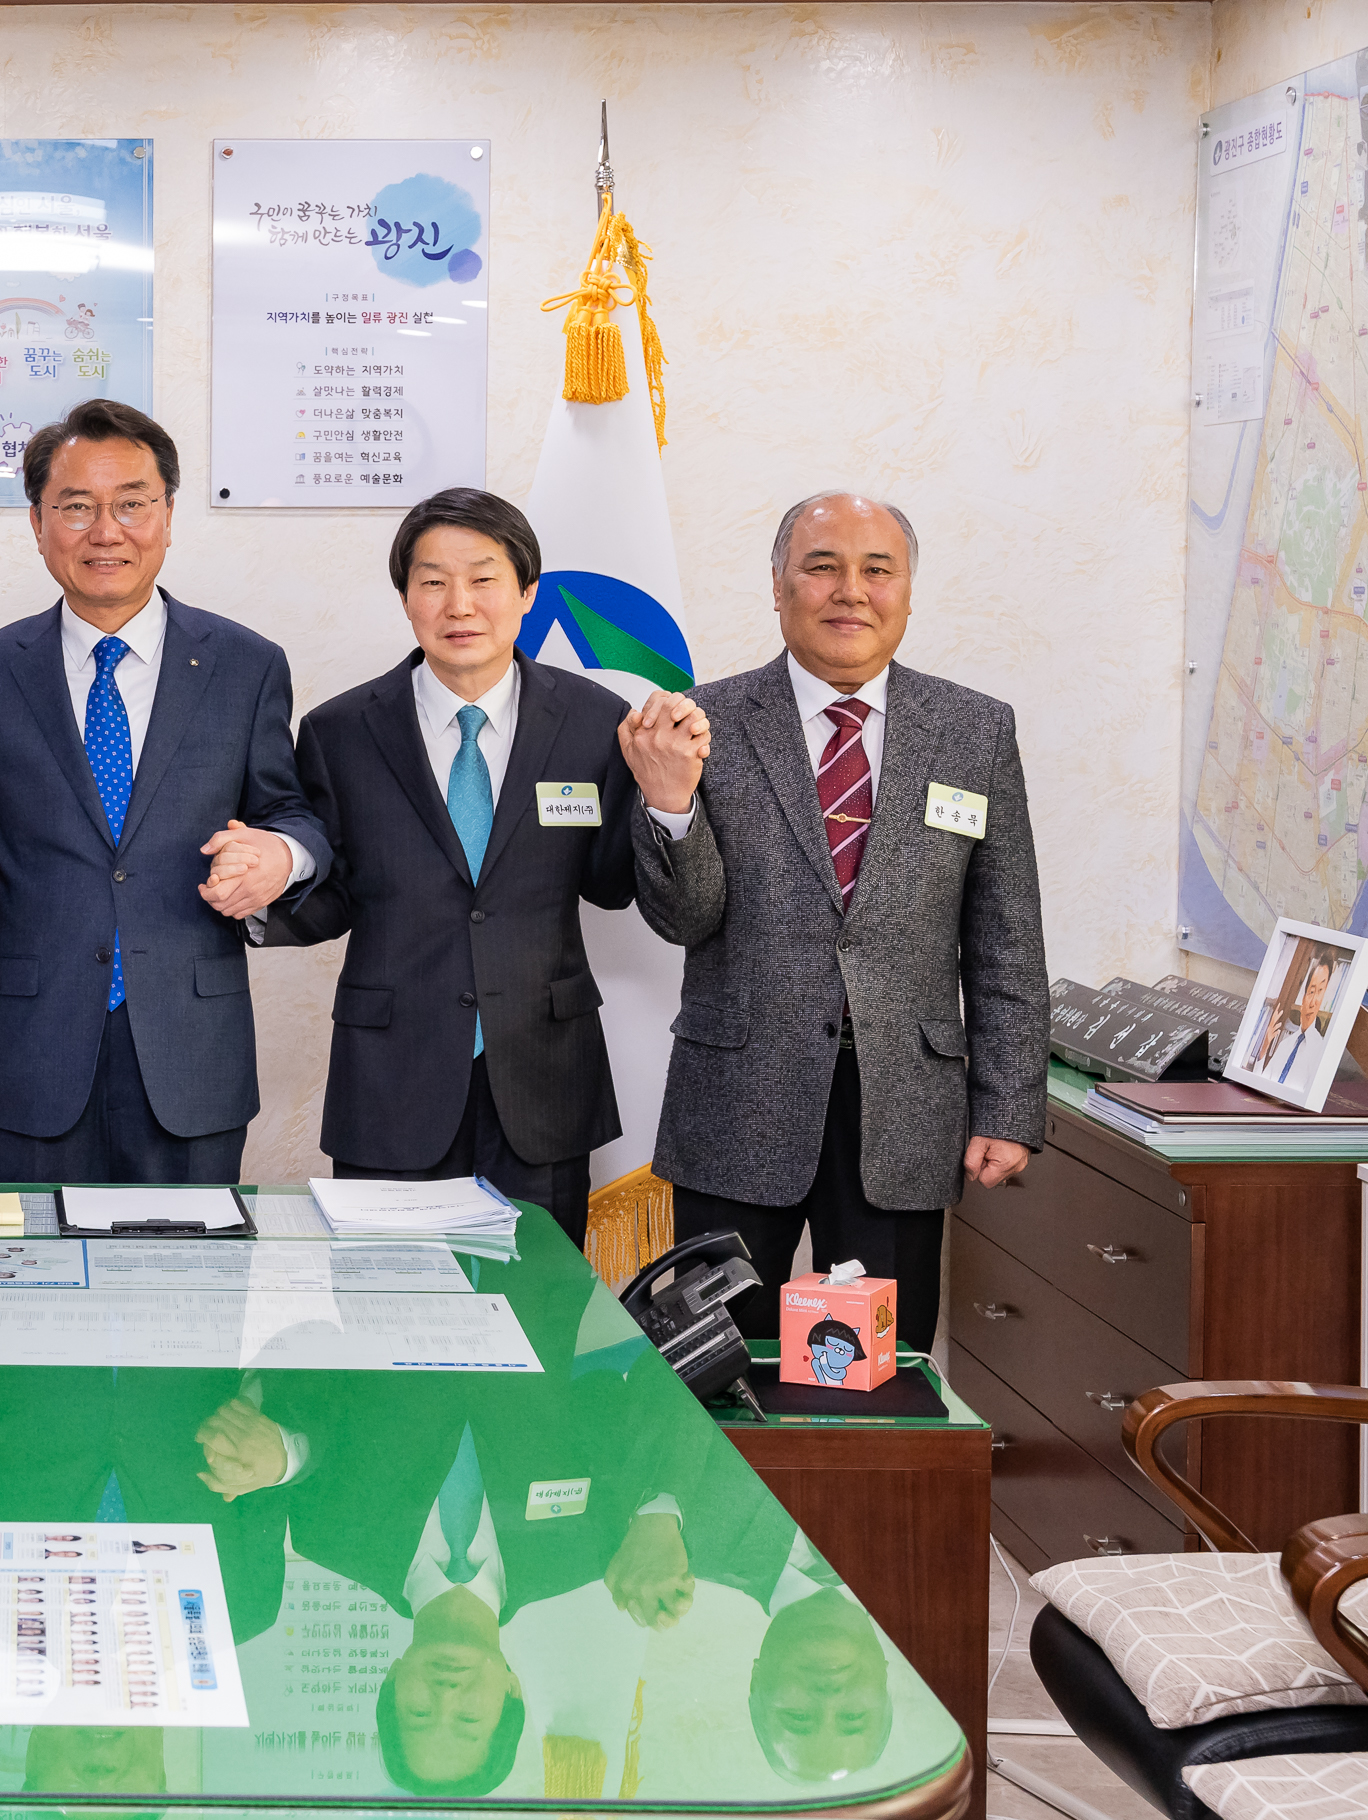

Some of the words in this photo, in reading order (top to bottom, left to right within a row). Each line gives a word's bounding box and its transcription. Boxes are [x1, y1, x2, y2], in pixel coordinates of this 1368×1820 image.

[1224, 135, 1244, 160] 광진구
[1247, 122, 1282, 152] 종합현황도
[250, 202, 293, 231] 구민이
[297, 202, 344, 223] 꿈꾸는
[346, 204, 378, 219] 가치
[268, 225, 308, 246] 함께
[313, 226, 362, 246] 만드는
[364, 219, 454, 260] 광진
[332, 294, 368, 302] 구정목표
[267, 312, 320, 324] 지역가치를
[325, 312, 357, 324] 높이는
[361, 312, 382, 324] 일류
[386, 312, 408, 324] 광진
[412, 312, 434, 324] 실현
[24, 348, 62, 362] 꿈꾸는
[72, 348, 112, 362] 숨쉬는
[332, 348, 368, 356] 핵심전략
[29, 366, 56, 378] 도시
[78, 366, 104, 378] 도시
[314, 365, 356, 376] 도약하는
[362, 365, 404, 376] 지역가치
[313, 386, 355, 397] 살맛나는
[362, 386, 404, 397] 활력경제
[313, 408, 355, 419] 더나은삶
[362, 408, 403, 419] 맞춤복지
[313, 430, 354, 441] 구민안심
[362, 430, 403, 441] 생활안전
[313, 452, 354, 462] 꿈을여는
[360, 452, 402, 462] 혁신교육
[313, 474, 354, 484] 풍요로운
[360, 474, 403, 484] 예술문화
[786, 1293, 828, 1310] Kleenex
